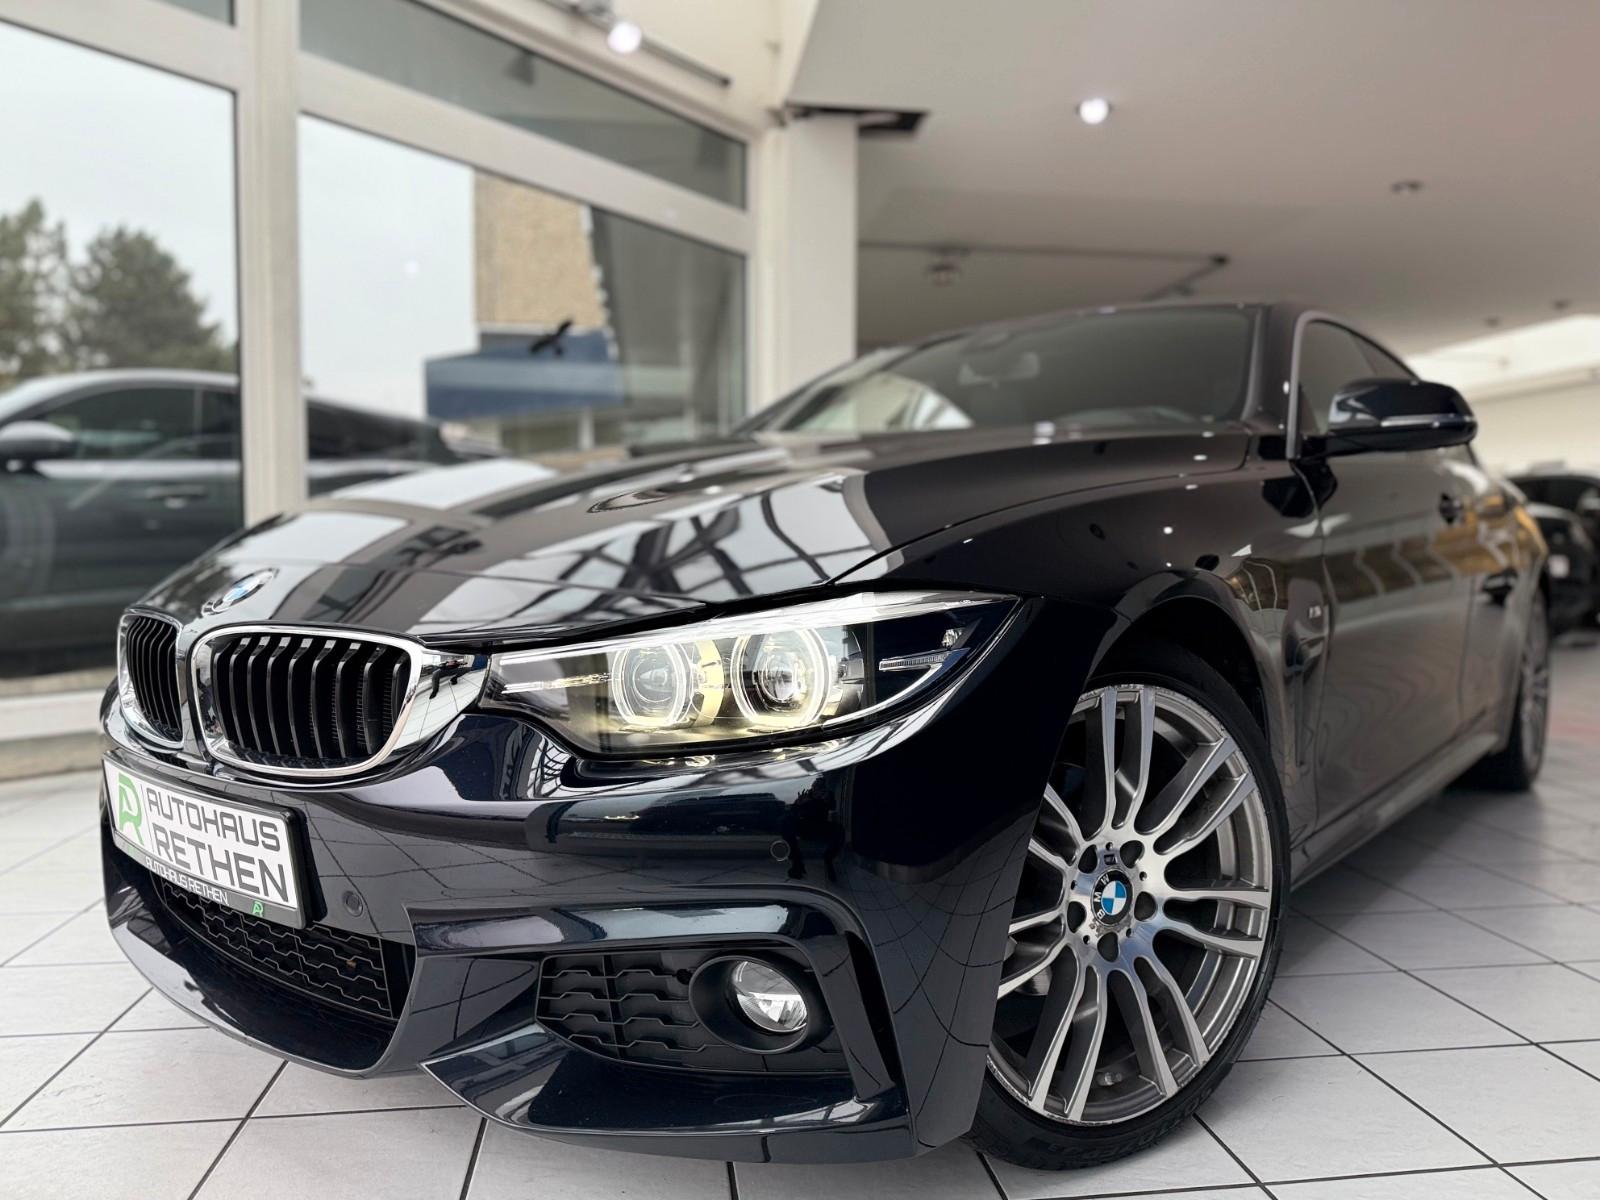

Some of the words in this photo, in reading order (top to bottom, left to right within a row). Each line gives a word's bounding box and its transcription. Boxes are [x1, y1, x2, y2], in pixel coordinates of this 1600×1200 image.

[146, 787, 280, 852] AUTOHAUS
[152, 822, 289, 902] RETHEN
[188, 877, 229, 906] RETHEN
[1093, 873, 1110, 920] BMW
